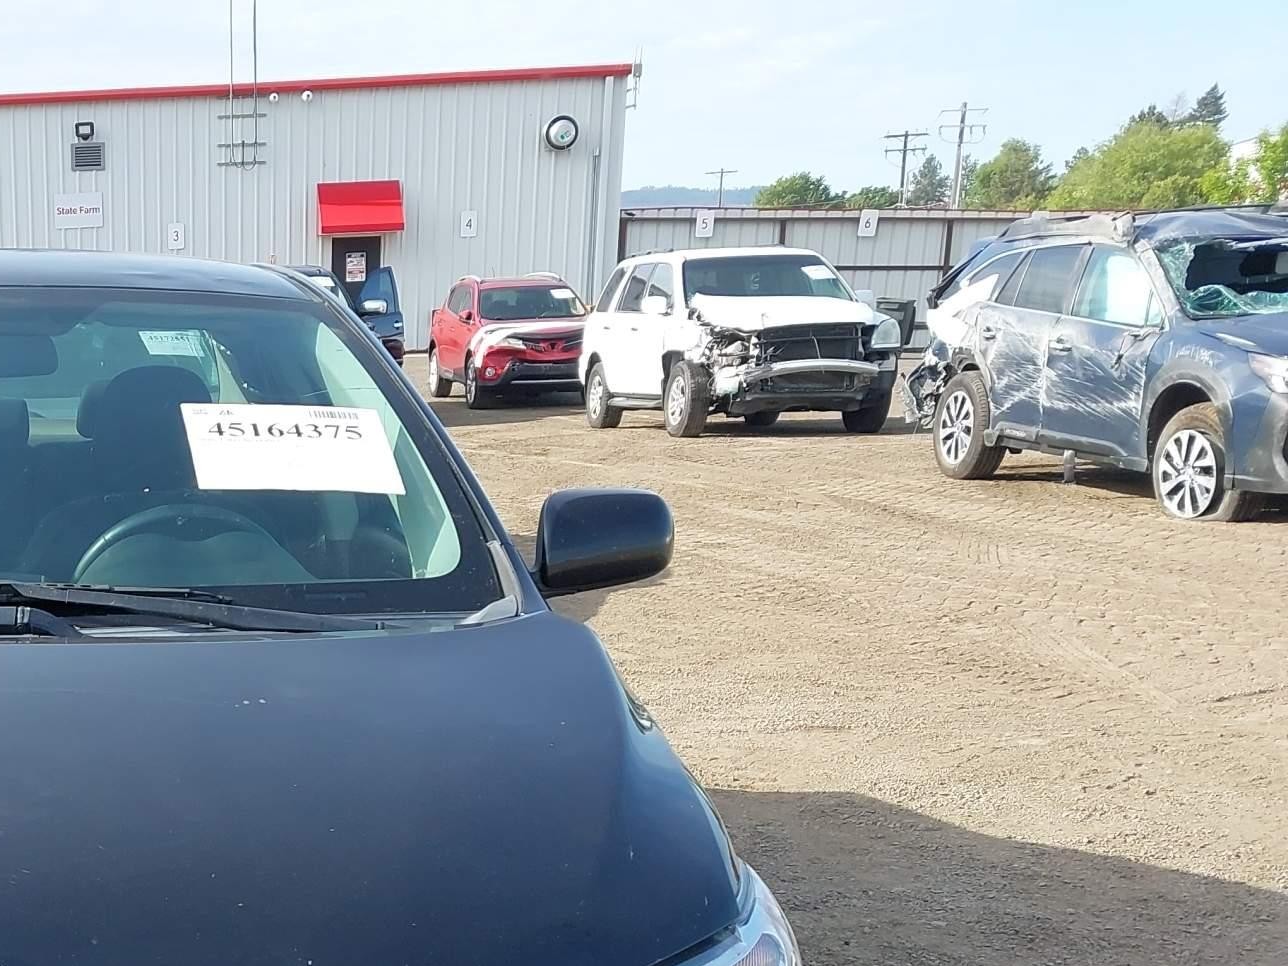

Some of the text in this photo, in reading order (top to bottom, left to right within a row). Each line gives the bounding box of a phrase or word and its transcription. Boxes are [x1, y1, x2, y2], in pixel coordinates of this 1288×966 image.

[56, 205, 101, 215] State Farm
[465, 218, 473, 230] 4
[701, 217, 709, 230] 5
[864, 217, 871, 229] 6
[172, 230, 180, 242] 3
[208, 422, 363, 440] 45164375
